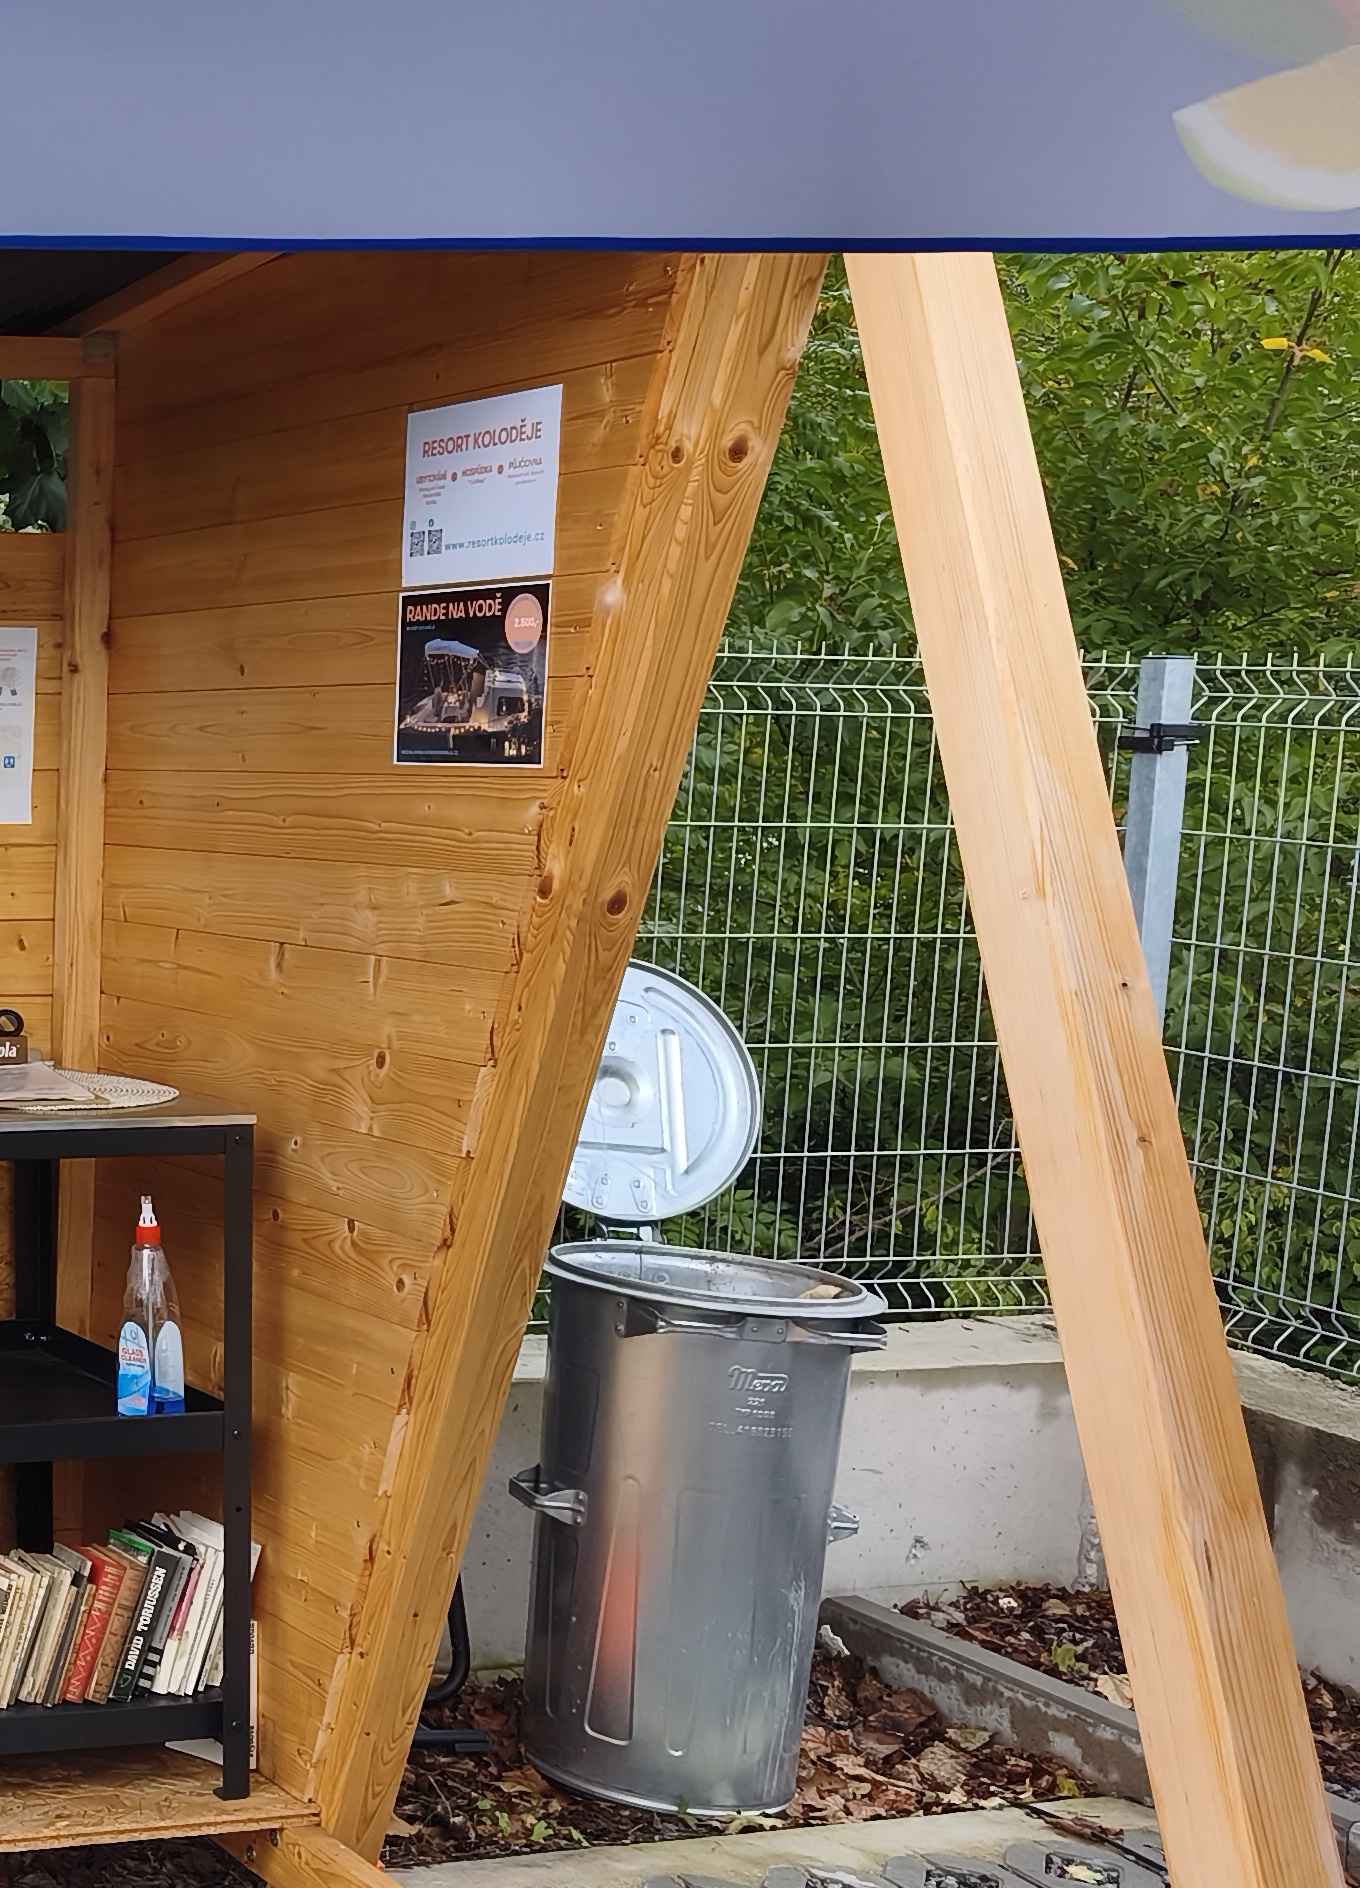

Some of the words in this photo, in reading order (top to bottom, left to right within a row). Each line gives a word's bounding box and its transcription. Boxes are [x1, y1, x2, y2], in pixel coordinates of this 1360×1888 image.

[422, 434, 471, 459] RESORT
[473, 417, 543, 450] KOLODĚJE
[406, 603, 447, 623] RANDE
[448, 601, 466, 619] NA
[467, 592, 503, 618] VODĚ
[124, 1635, 144, 1671] DAVID
[136, 1566, 168, 1632] TORJUSSEN
